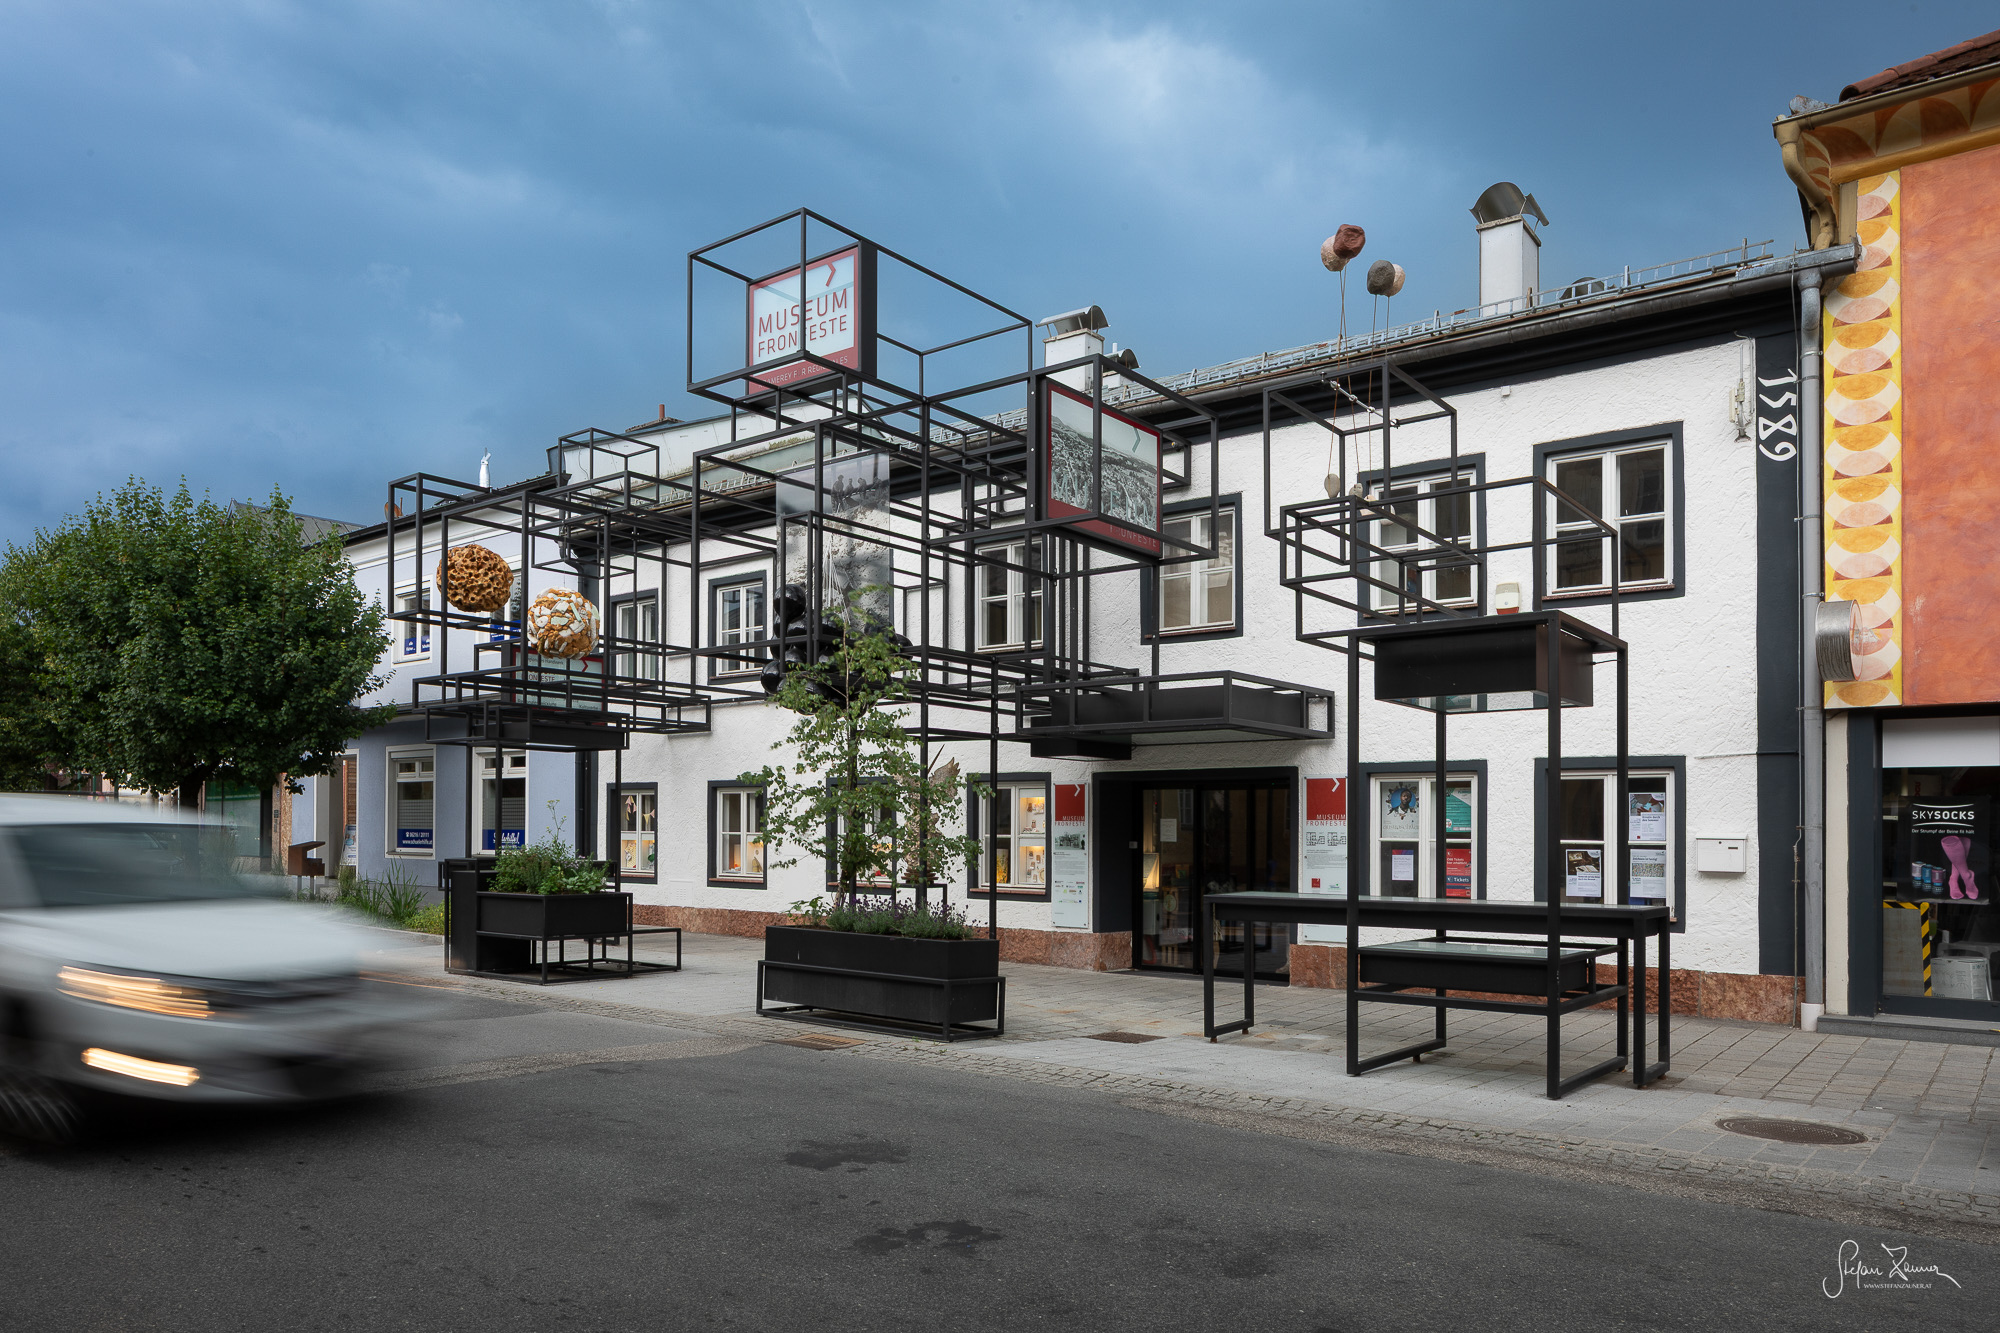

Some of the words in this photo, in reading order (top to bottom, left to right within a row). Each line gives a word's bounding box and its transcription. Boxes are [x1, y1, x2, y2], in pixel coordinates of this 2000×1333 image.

[758, 288, 848, 337] MUSEUM
[758, 314, 847, 358] FRONESTE
[1051, 470, 1156, 531] MUEUM
[1912, 810, 1975, 820] SKYSOCKS
